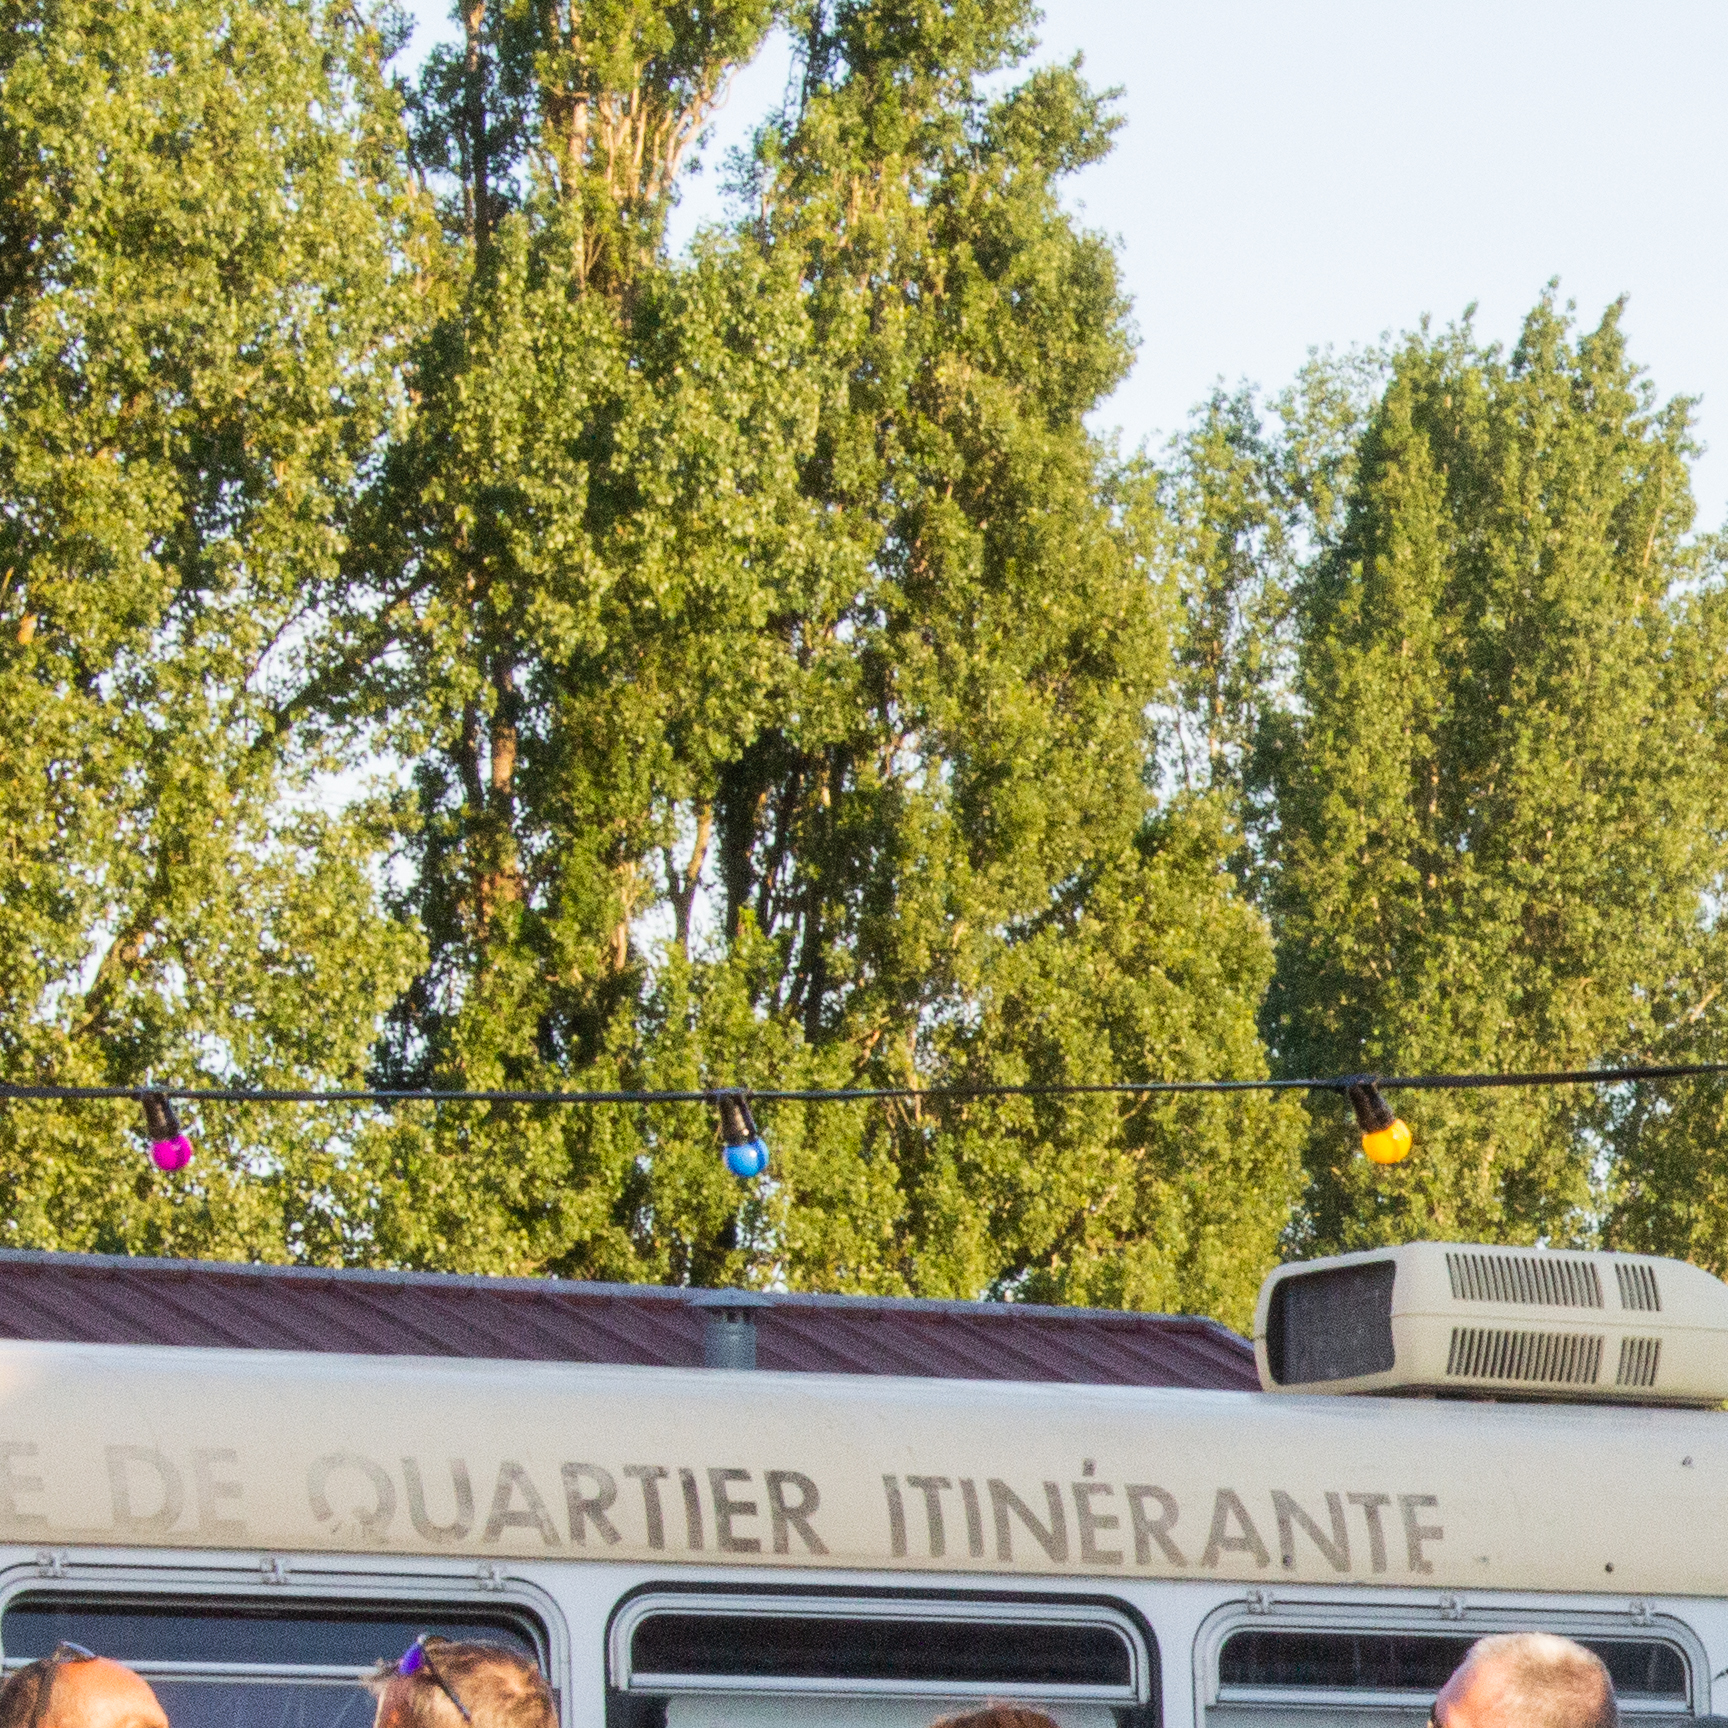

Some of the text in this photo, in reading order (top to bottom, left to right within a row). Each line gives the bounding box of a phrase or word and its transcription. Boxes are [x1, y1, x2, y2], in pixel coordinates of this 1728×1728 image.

[0, 1440, 1445, 1575] E DE QUARTIER ITINÉRANTE
